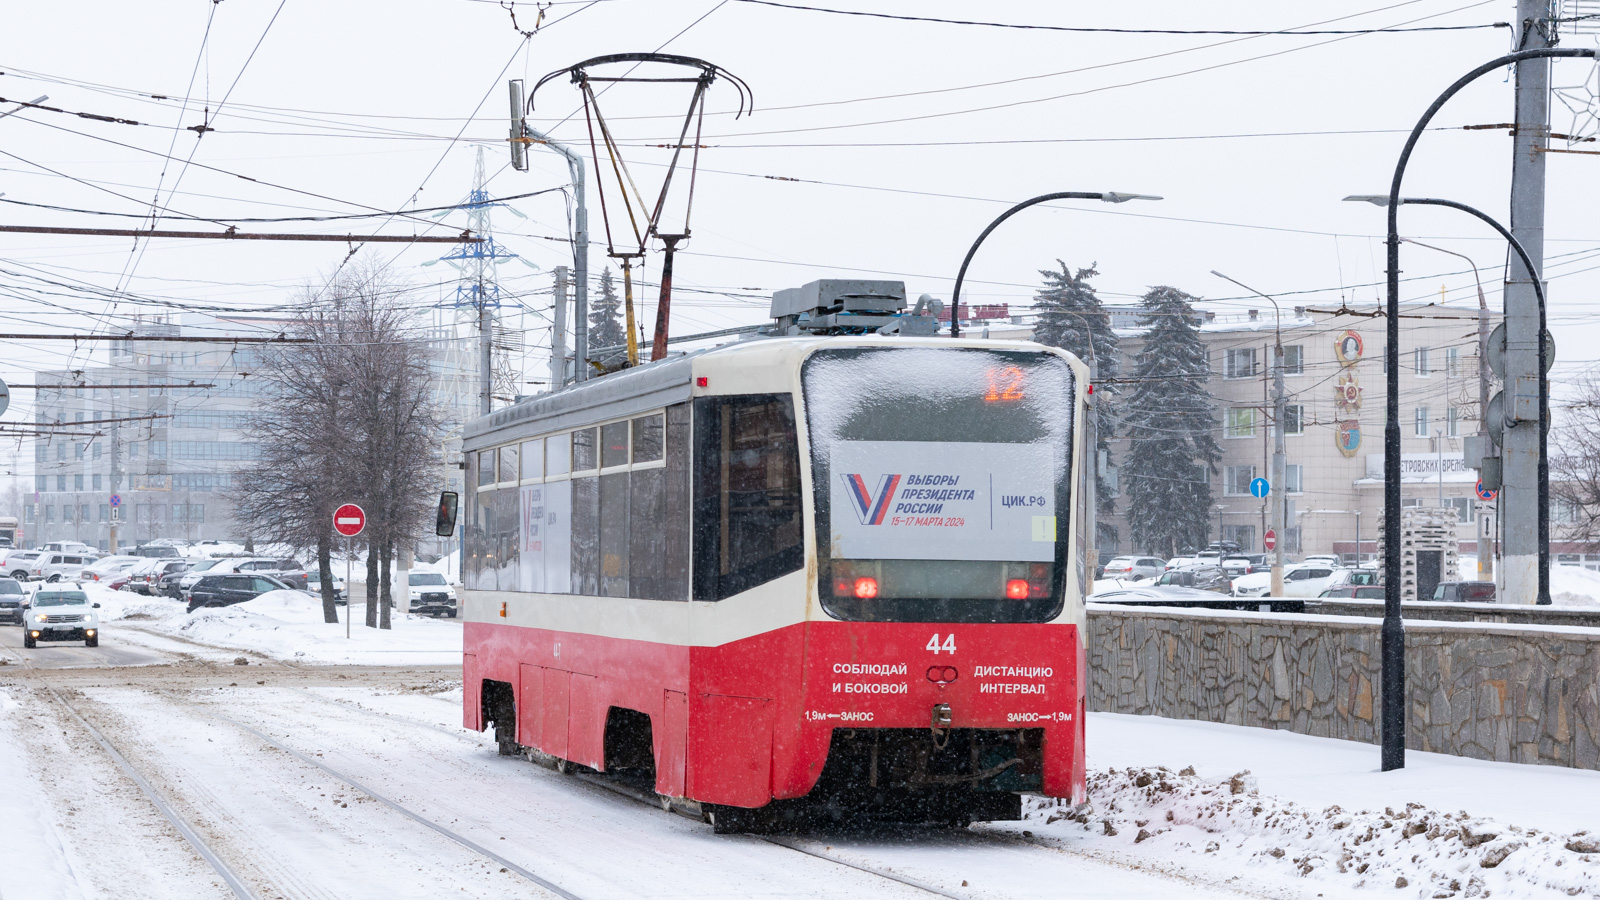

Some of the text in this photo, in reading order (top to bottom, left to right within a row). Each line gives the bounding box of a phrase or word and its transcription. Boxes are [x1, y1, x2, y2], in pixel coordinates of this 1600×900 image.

[986, 367, 1023, 401] 12
[1400, 459, 1439, 473] ЕТРОВСКИХ
[906, 474, 960, 486] ВЫБОРЫ
[901, 488, 975, 501] ПРЕЗИДЕНТА
[895, 503, 944, 514] РОССИИ
[1001, 495, 1046, 509] ЦИК.РФ
[914, 516, 944, 527] МАРТА
[944, 517, 965, 527] 2024
[926, 633, 957, 655] 44
[833, 662, 1054, 679] СОБЛЮДАЙ ДИСТАНЦИЮ
[832, 681, 1046, 695] И БОКОВОЙ ИНТЕРВАЛ
[840, 711, 874, 721] ЗАНОС
[1007, 711, 1039, 722] ЗАНОС
